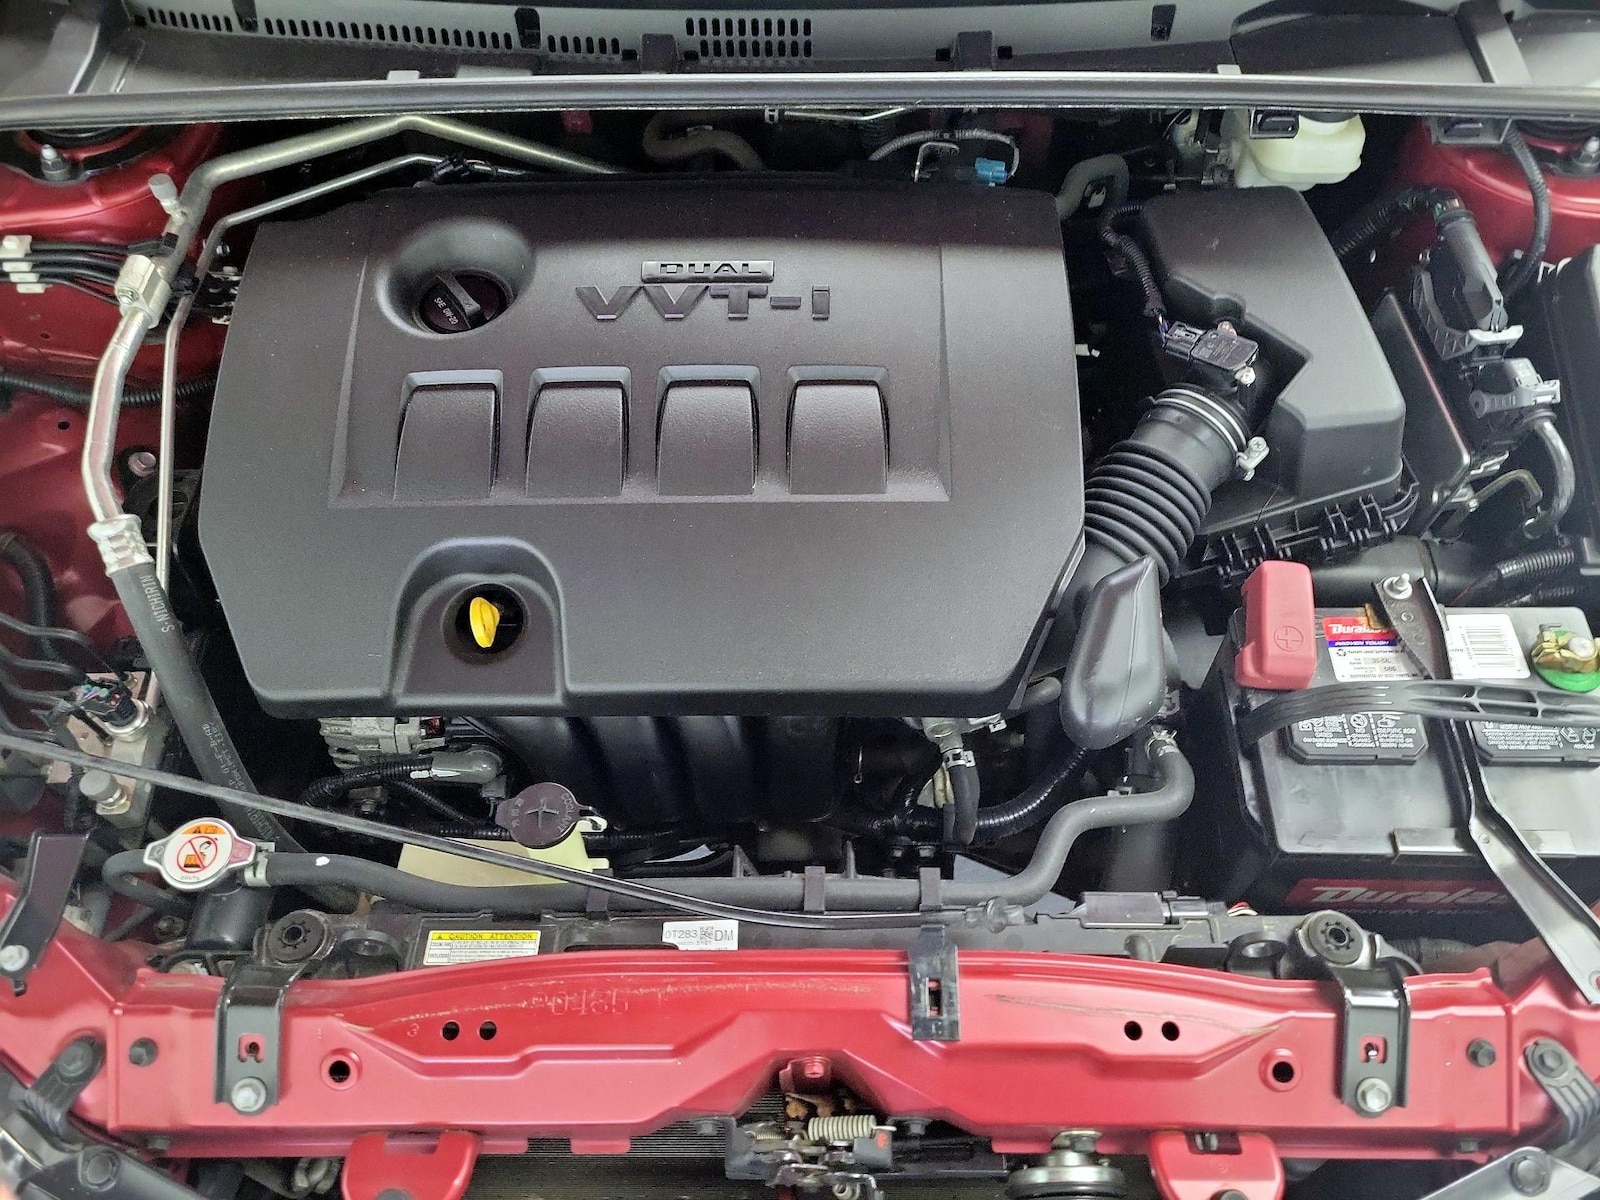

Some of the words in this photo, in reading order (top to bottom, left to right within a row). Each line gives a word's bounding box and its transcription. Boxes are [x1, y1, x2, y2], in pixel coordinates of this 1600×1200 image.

[659, 262, 762, 275] DUAL
[433, 296, 447, 309] SAE
[443, 307, 459, 325] 0W-20
[449, 932, 483, 940] CAUTION
[490, 932, 534, 940] ATTENTION
